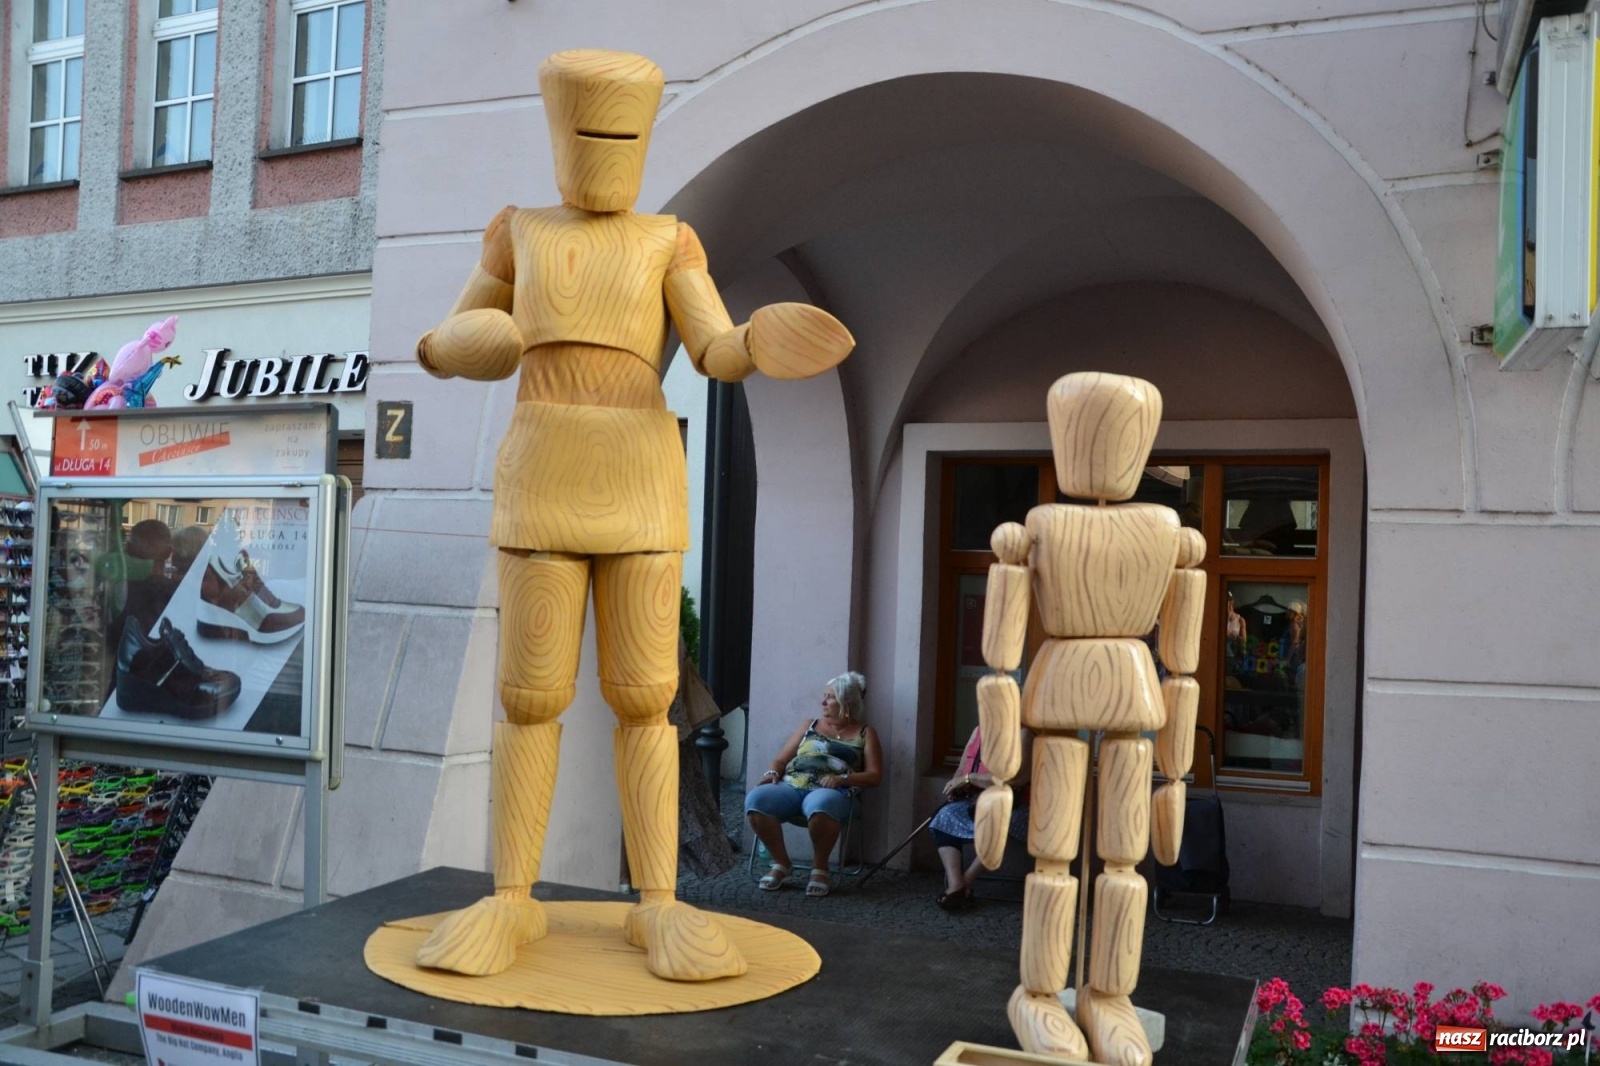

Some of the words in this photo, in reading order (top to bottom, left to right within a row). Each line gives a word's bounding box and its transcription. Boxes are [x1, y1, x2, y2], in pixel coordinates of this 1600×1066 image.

[183, 348, 369, 401] JUBILE
[265, 420, 322, 432] zapraszamy
[385, 408, 406, 443] Z
[140, 420, 230, 446] OBUWIE
[287, 436, 299, 444] na
[89, 438, 100, 451] 50
[275, 447, 310, 458] zakupy
[62, 457, 95, 472] DŁUGA
[99, 457, 112, 471] 14
[294, 530, 308, 540] 14
[148, 992, 246, 1028] WoodenWowMen
